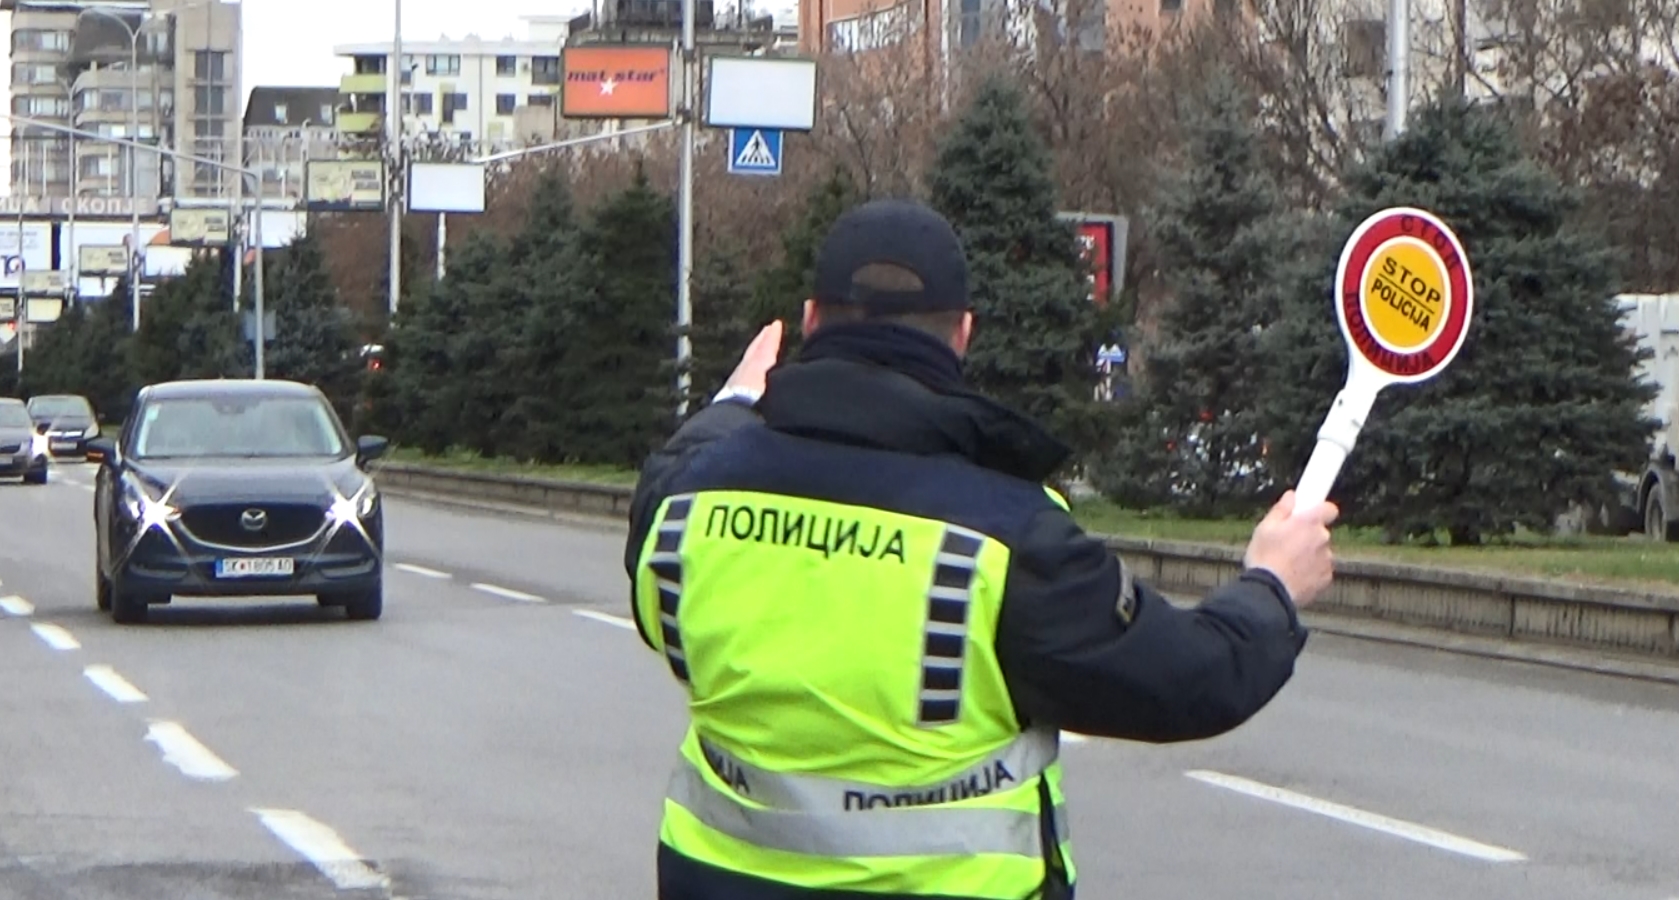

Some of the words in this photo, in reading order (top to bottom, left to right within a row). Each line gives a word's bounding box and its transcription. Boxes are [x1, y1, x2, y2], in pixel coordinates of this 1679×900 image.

[61, 198, 149, 214] СКОПЈЕ
[1382, 256, 1441, 303] STOP
[1371, 278, 1431, 332] POLICIJA
[705, 505, 907, 564] ПОЛИЦИЈА
